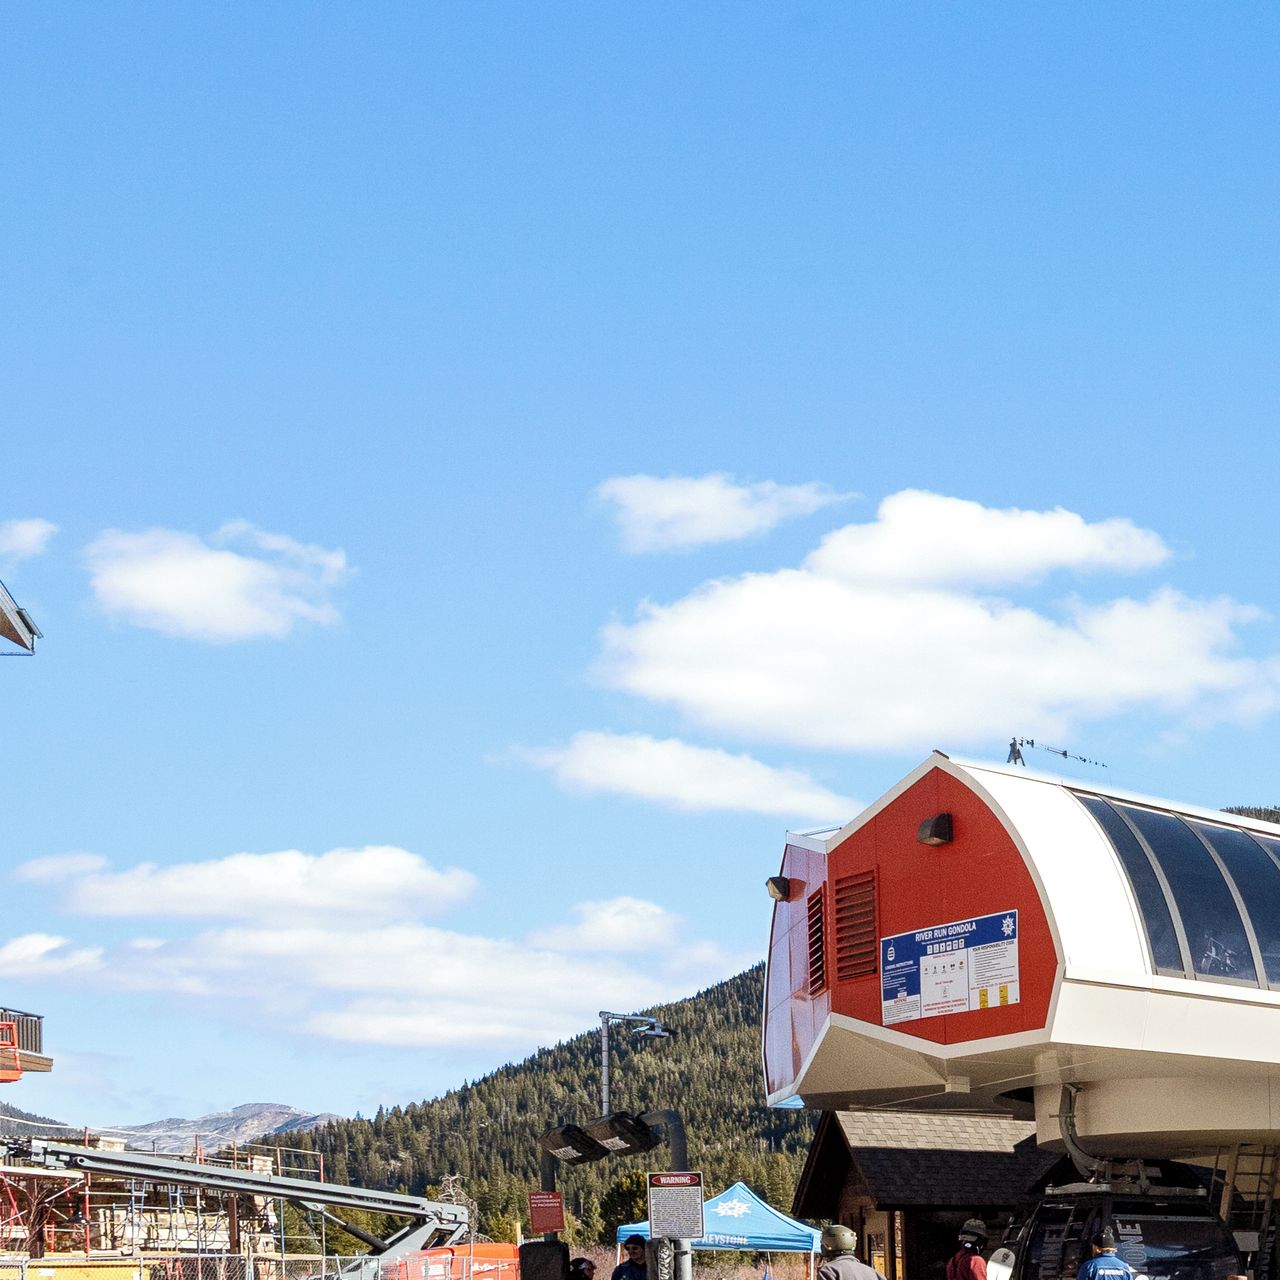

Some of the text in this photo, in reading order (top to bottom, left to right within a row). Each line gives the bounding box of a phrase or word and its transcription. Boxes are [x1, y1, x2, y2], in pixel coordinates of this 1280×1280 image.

[915, 930, 933, 942] RIVER
[933, 927, 947, 938] RUN
[948, 921, 976, 935] GONDOLA
[660, 1176, 690, 1184] WARNING
[702, 1233, 748, 1245] KEYSTONE
